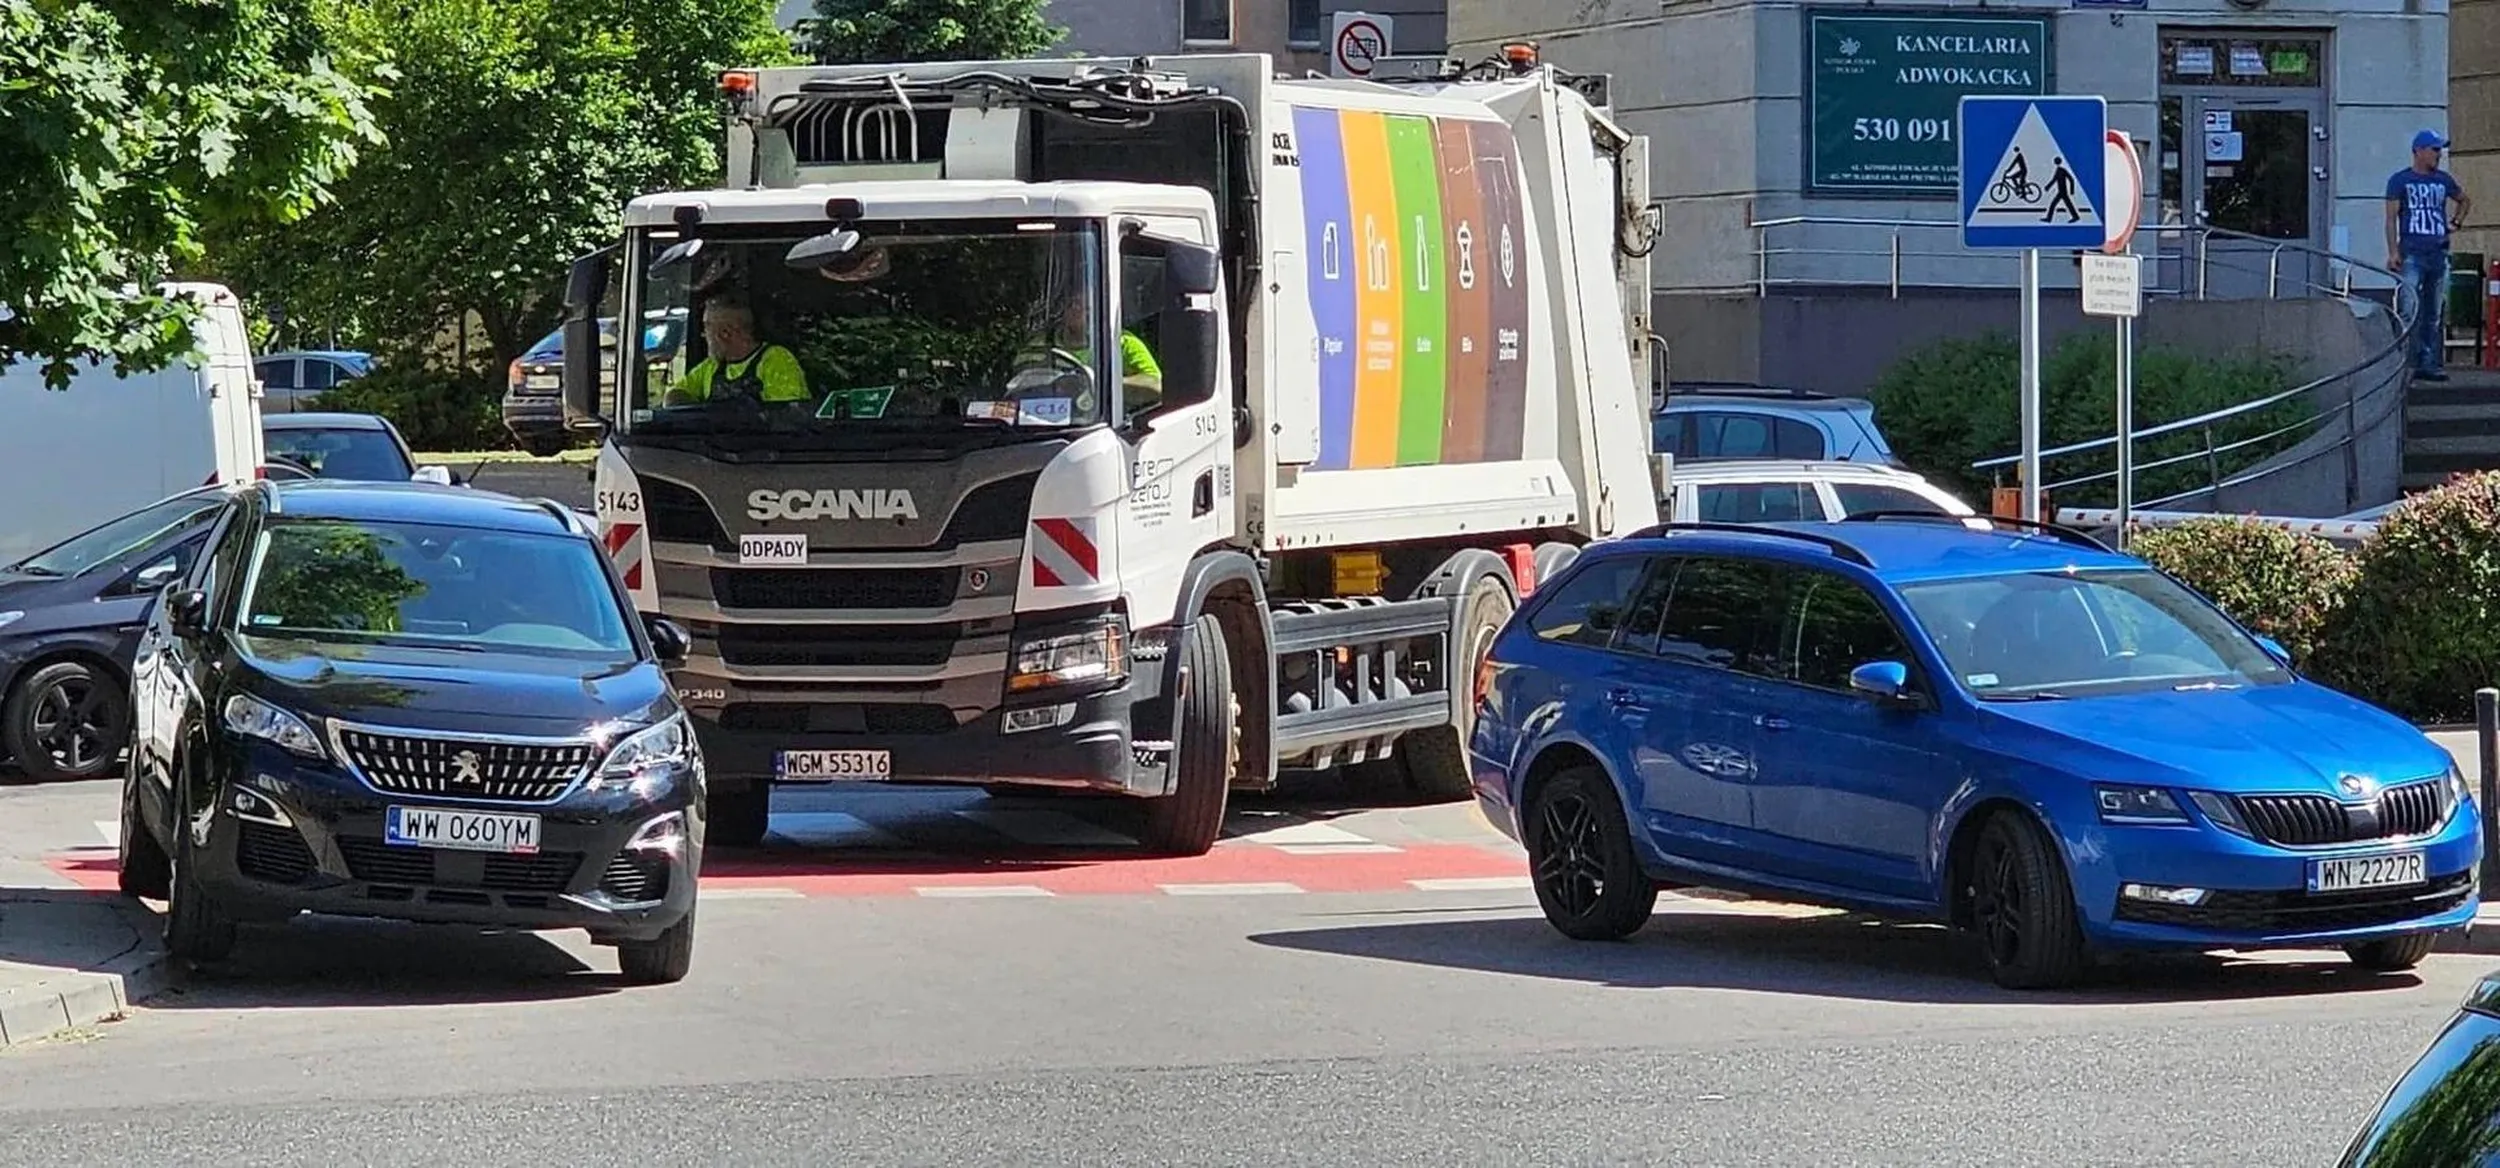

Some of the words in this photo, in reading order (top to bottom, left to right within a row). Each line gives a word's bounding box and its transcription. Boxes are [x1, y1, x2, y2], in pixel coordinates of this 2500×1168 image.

[1896, 35, 2031, 54] KANCELARIA
[1895, 67, 2032, 86] ADWOKACKA
[1853, 117, 1900, 142] 530
[1907, 118, 1950, 142] 091
[1034, 402, 1068, 415] C16
[1195, 413, 1218, 437] S143
[1132, 459, 1156, 480] pre
[598, 491, 640, 513] S143
[747, 488, 919, 521] SCANIA
[1130, 483, 1162, 504] zero
[741, 539, 805, 560] ODPADY
[786, 753, 824, 774] WGM
[829, 752, 888, 774] 55316
[406, 811, 440, 839] WW
[450, 815, 533, 845] 060YM
[2322, 860, 2352, 887] WN
[2359, 854, 2421, 885] 2227R
